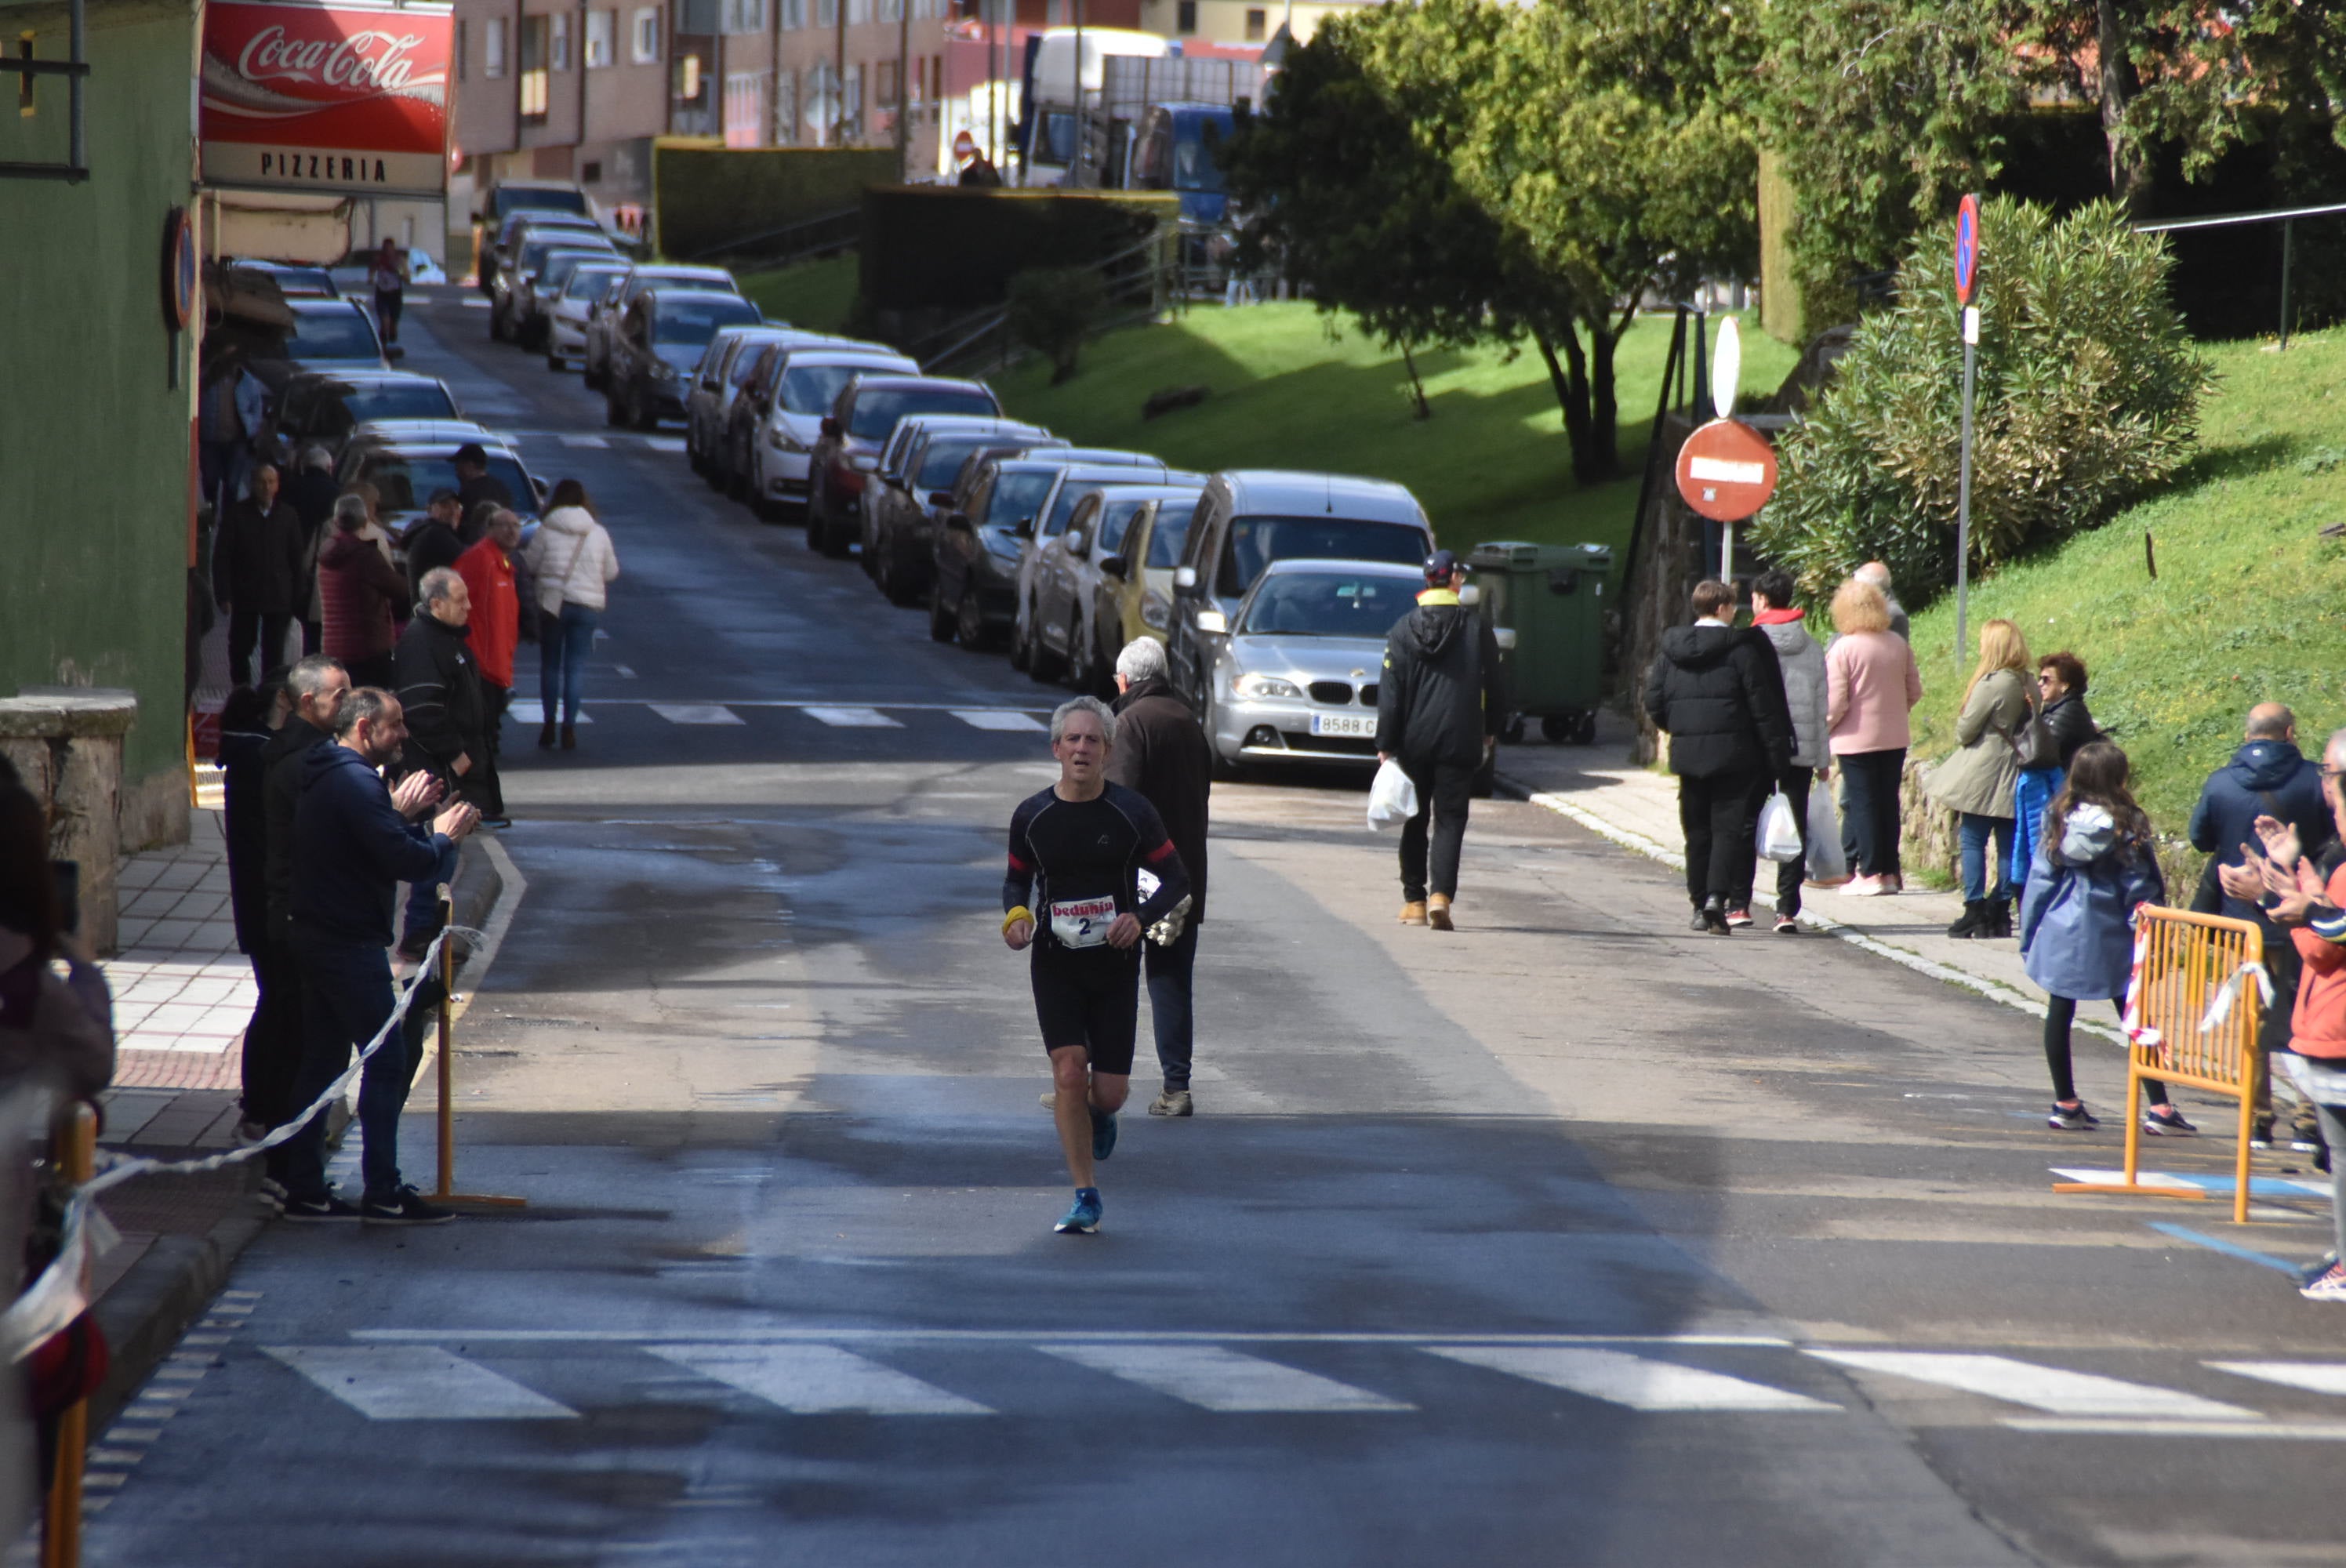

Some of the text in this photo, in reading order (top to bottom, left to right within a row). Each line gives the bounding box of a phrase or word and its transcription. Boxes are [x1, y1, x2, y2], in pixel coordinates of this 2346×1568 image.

[238, 25, 427, 89] Coca-Cola
[261, 152, 386, 182] PIZZERIA
[1322, 717, 1360, 734] 8588
[1079, 917, 1091, 935] 2
